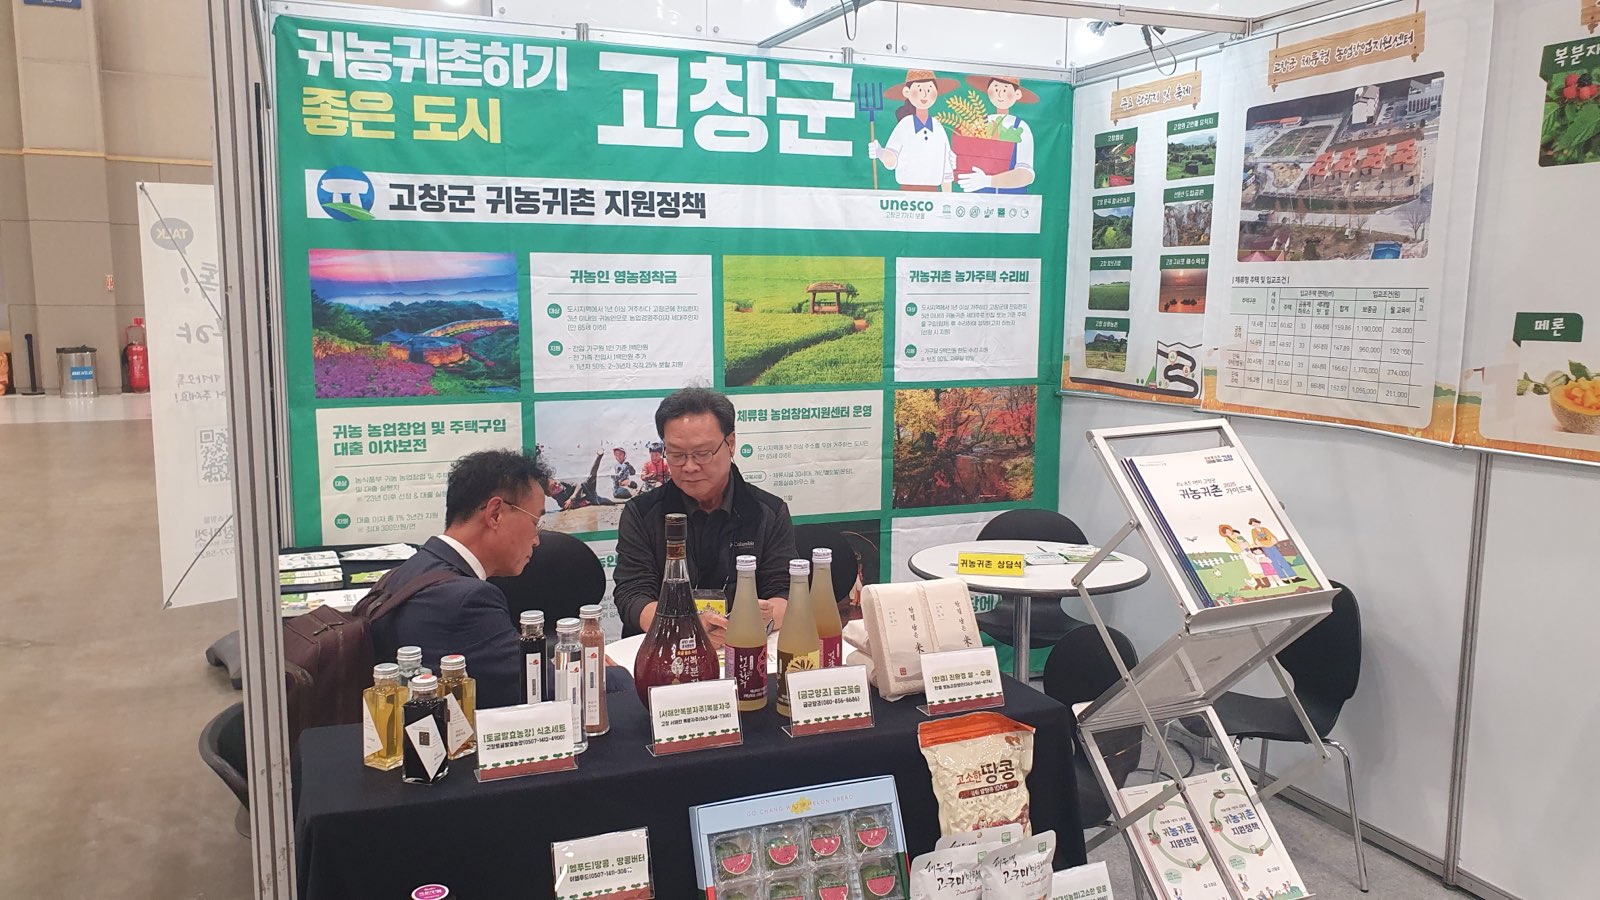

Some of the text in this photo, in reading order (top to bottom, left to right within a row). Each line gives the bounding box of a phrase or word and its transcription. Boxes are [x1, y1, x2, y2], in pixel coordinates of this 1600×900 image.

[1273, 30, 1414, 72] 고창군 체류형 농업창업지원센터
[297, 29, 856, 157] 귀농귀촌하기 고창군
[301, 87, 501, 143] 좋은 도시
[388, 181, 706, 219] 고창군 귀농귀촌 지원정책
[880, 200, 934, 211] unesco
[570, 270, 677, 283] 귀농인 영농정착금
[910, 270, 1029, 282] 귀농귀촌 농가주택 수리비
[1534, 317, 1565, 338] 메론
[737, 405, 872, 422] 체류형 농업창업지원센터 운영
[333, 419, 506, 439] 귀농 농업창업 및 주택구입
[334, 439, 427, 456] 대출 이차보전
[1179, 484, 1223, 500] 귀농귀촌
[1225, 484, 1253, 495] 가이드북
[961, 559, 1022, 569] 귀농귀촌 상담석
[949, 672, 967, 681] 친환경
[798, 688, 832, 700] [금군양조]
[659, 702, 731, 718] [서해안복분자주]복분자주
[483, 724, 566, 743] [토굴발효농장] 식초세트
[956, 760, 1015, 786] 고소한 땅콩
[1223, 809, 1256, 824] 귀농귀촌
[1162, 823, 1195, 837] 귀농귀촌
[1231, 823, 1260, 836] 지원정책
[1169, 836, 1199, 849] 지원정책
[616, 854, 645, 866] 땅콩버터
